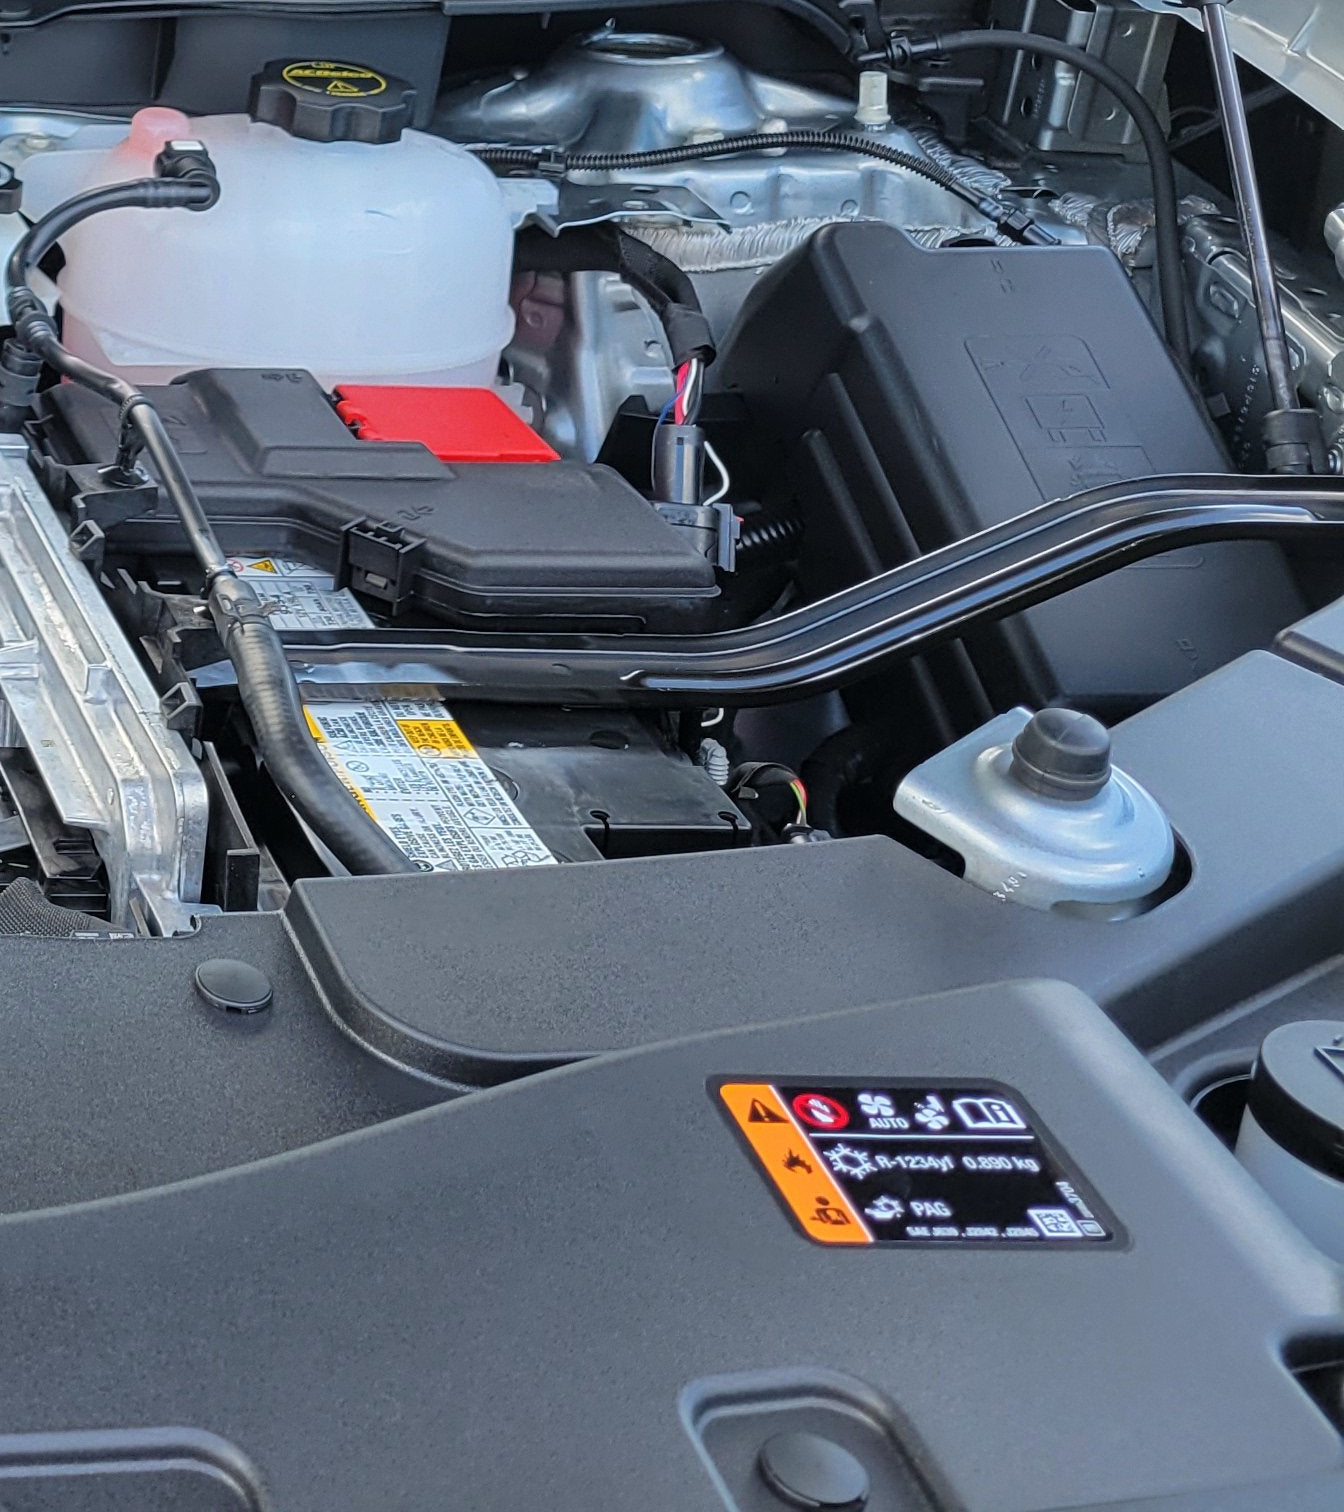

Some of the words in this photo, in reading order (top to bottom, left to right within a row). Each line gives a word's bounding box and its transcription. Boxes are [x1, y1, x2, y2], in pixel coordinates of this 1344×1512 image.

[868, 1117, 910, 1130] AUTO
[874, 1155, 955, 1172] R-1234yf
[962, 1155, 1013, 1170] 0.890
[1013, 1156, 1041, 1172] kg
[910, 1201, 952, 1217] PAG
